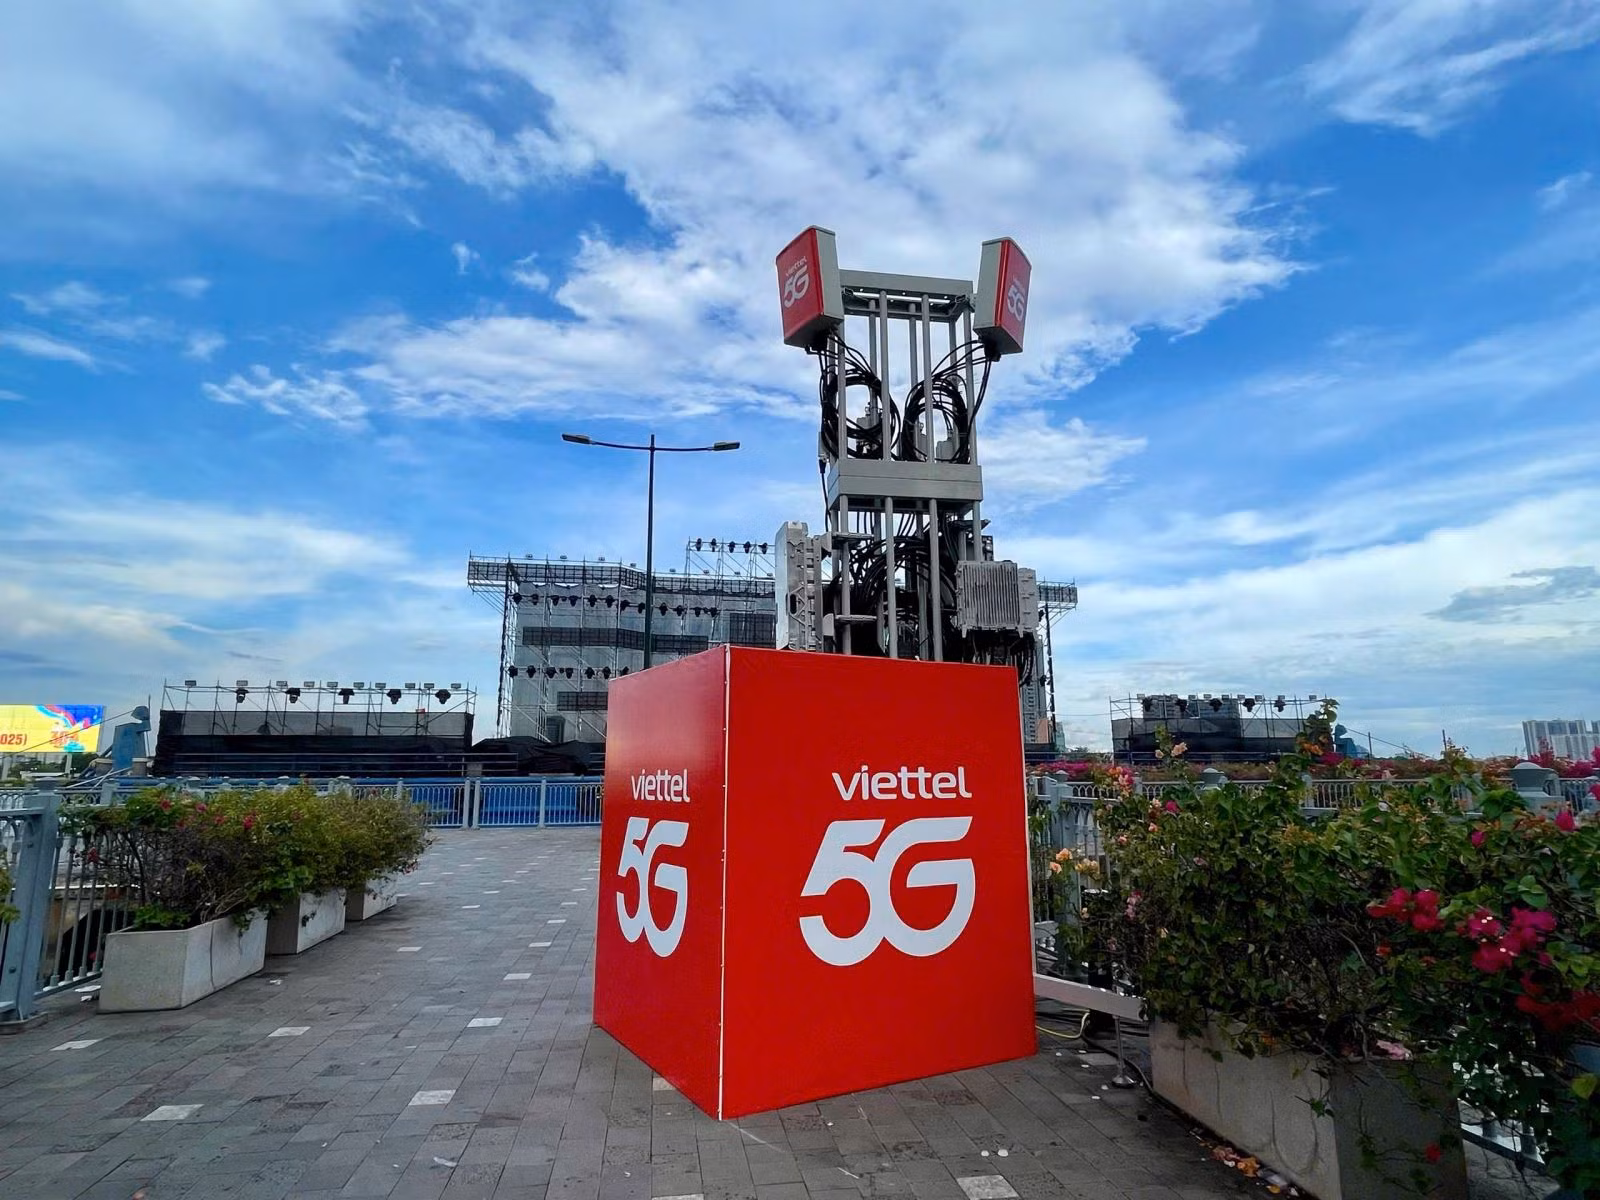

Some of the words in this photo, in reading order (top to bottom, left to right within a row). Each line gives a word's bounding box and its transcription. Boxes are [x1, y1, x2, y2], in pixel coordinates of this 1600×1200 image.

[784, 265, 810, 308] 5G
[1007, 284, 1025, 322] 5G
[631, 768, 691, 803] viettel
[831, 764, 973, 801] viettel
[616, 816, 690, 958] 5G
[799, 815, 976, 967] 5G
